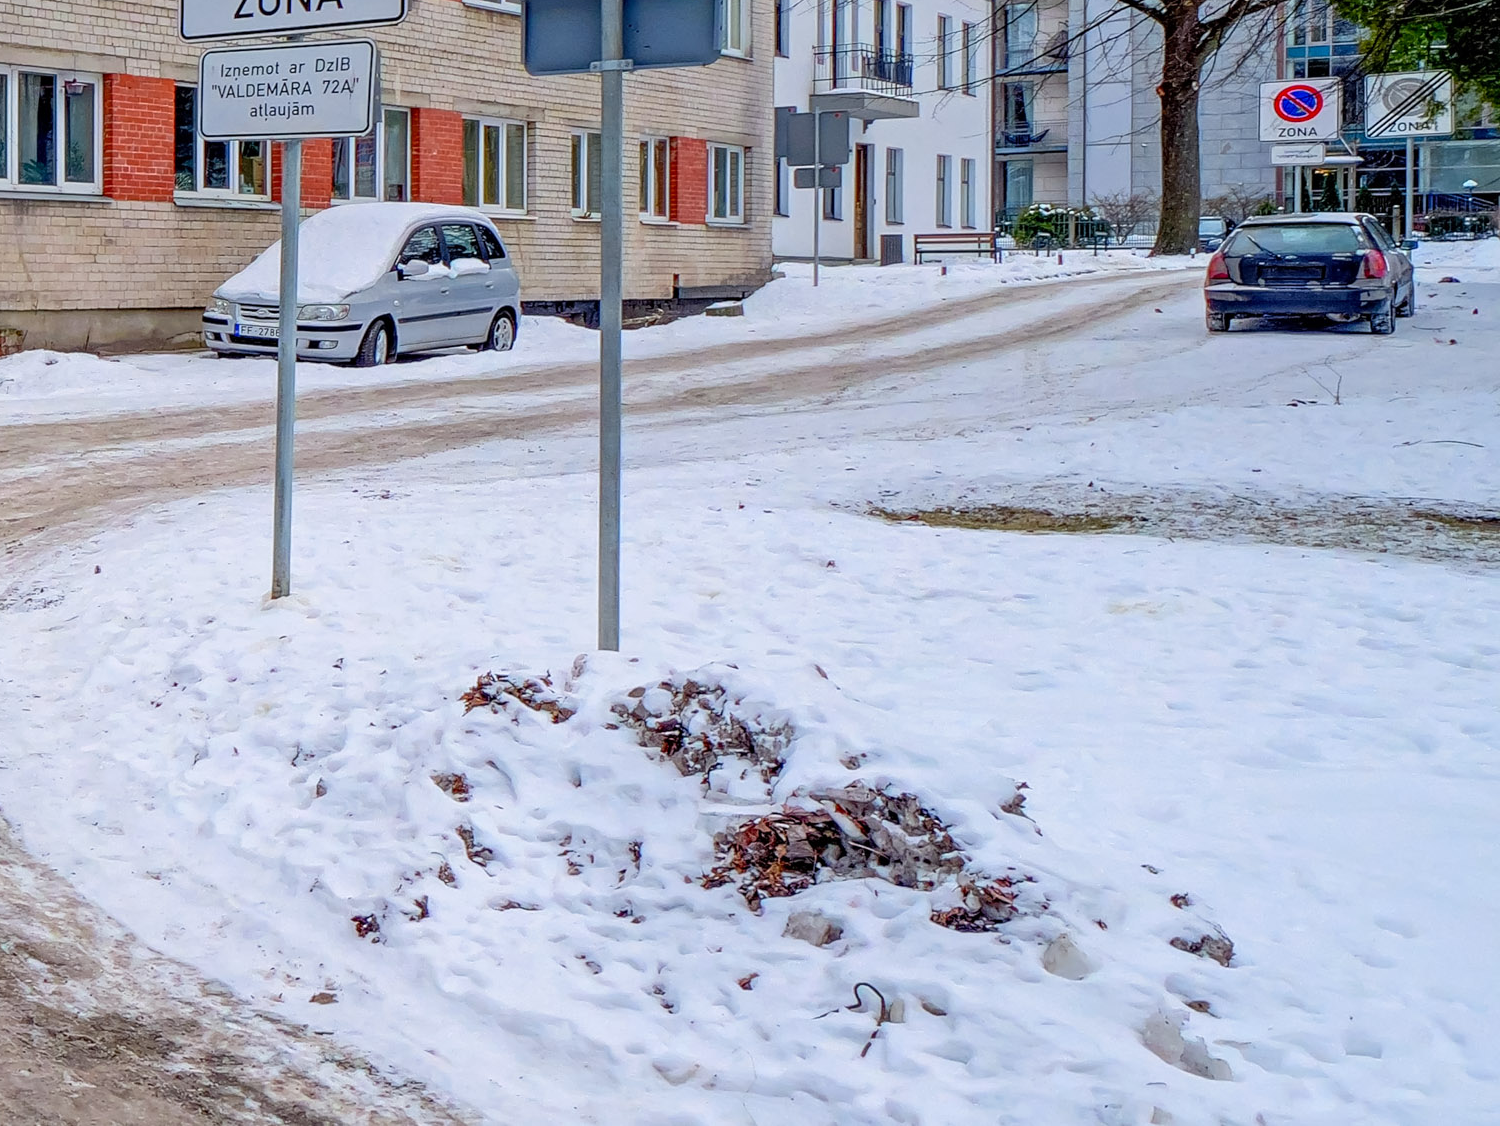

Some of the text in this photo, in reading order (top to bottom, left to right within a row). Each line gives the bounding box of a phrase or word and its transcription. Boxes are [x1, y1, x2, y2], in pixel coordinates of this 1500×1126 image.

[221, 57, 350, 80] Izņemot ar DzIB
[211, 79, 312, 98] "VALDEMĀRA
[249, 102, 315, 121] atļaujām
[1278, 127, 1318, 138] ZONA
